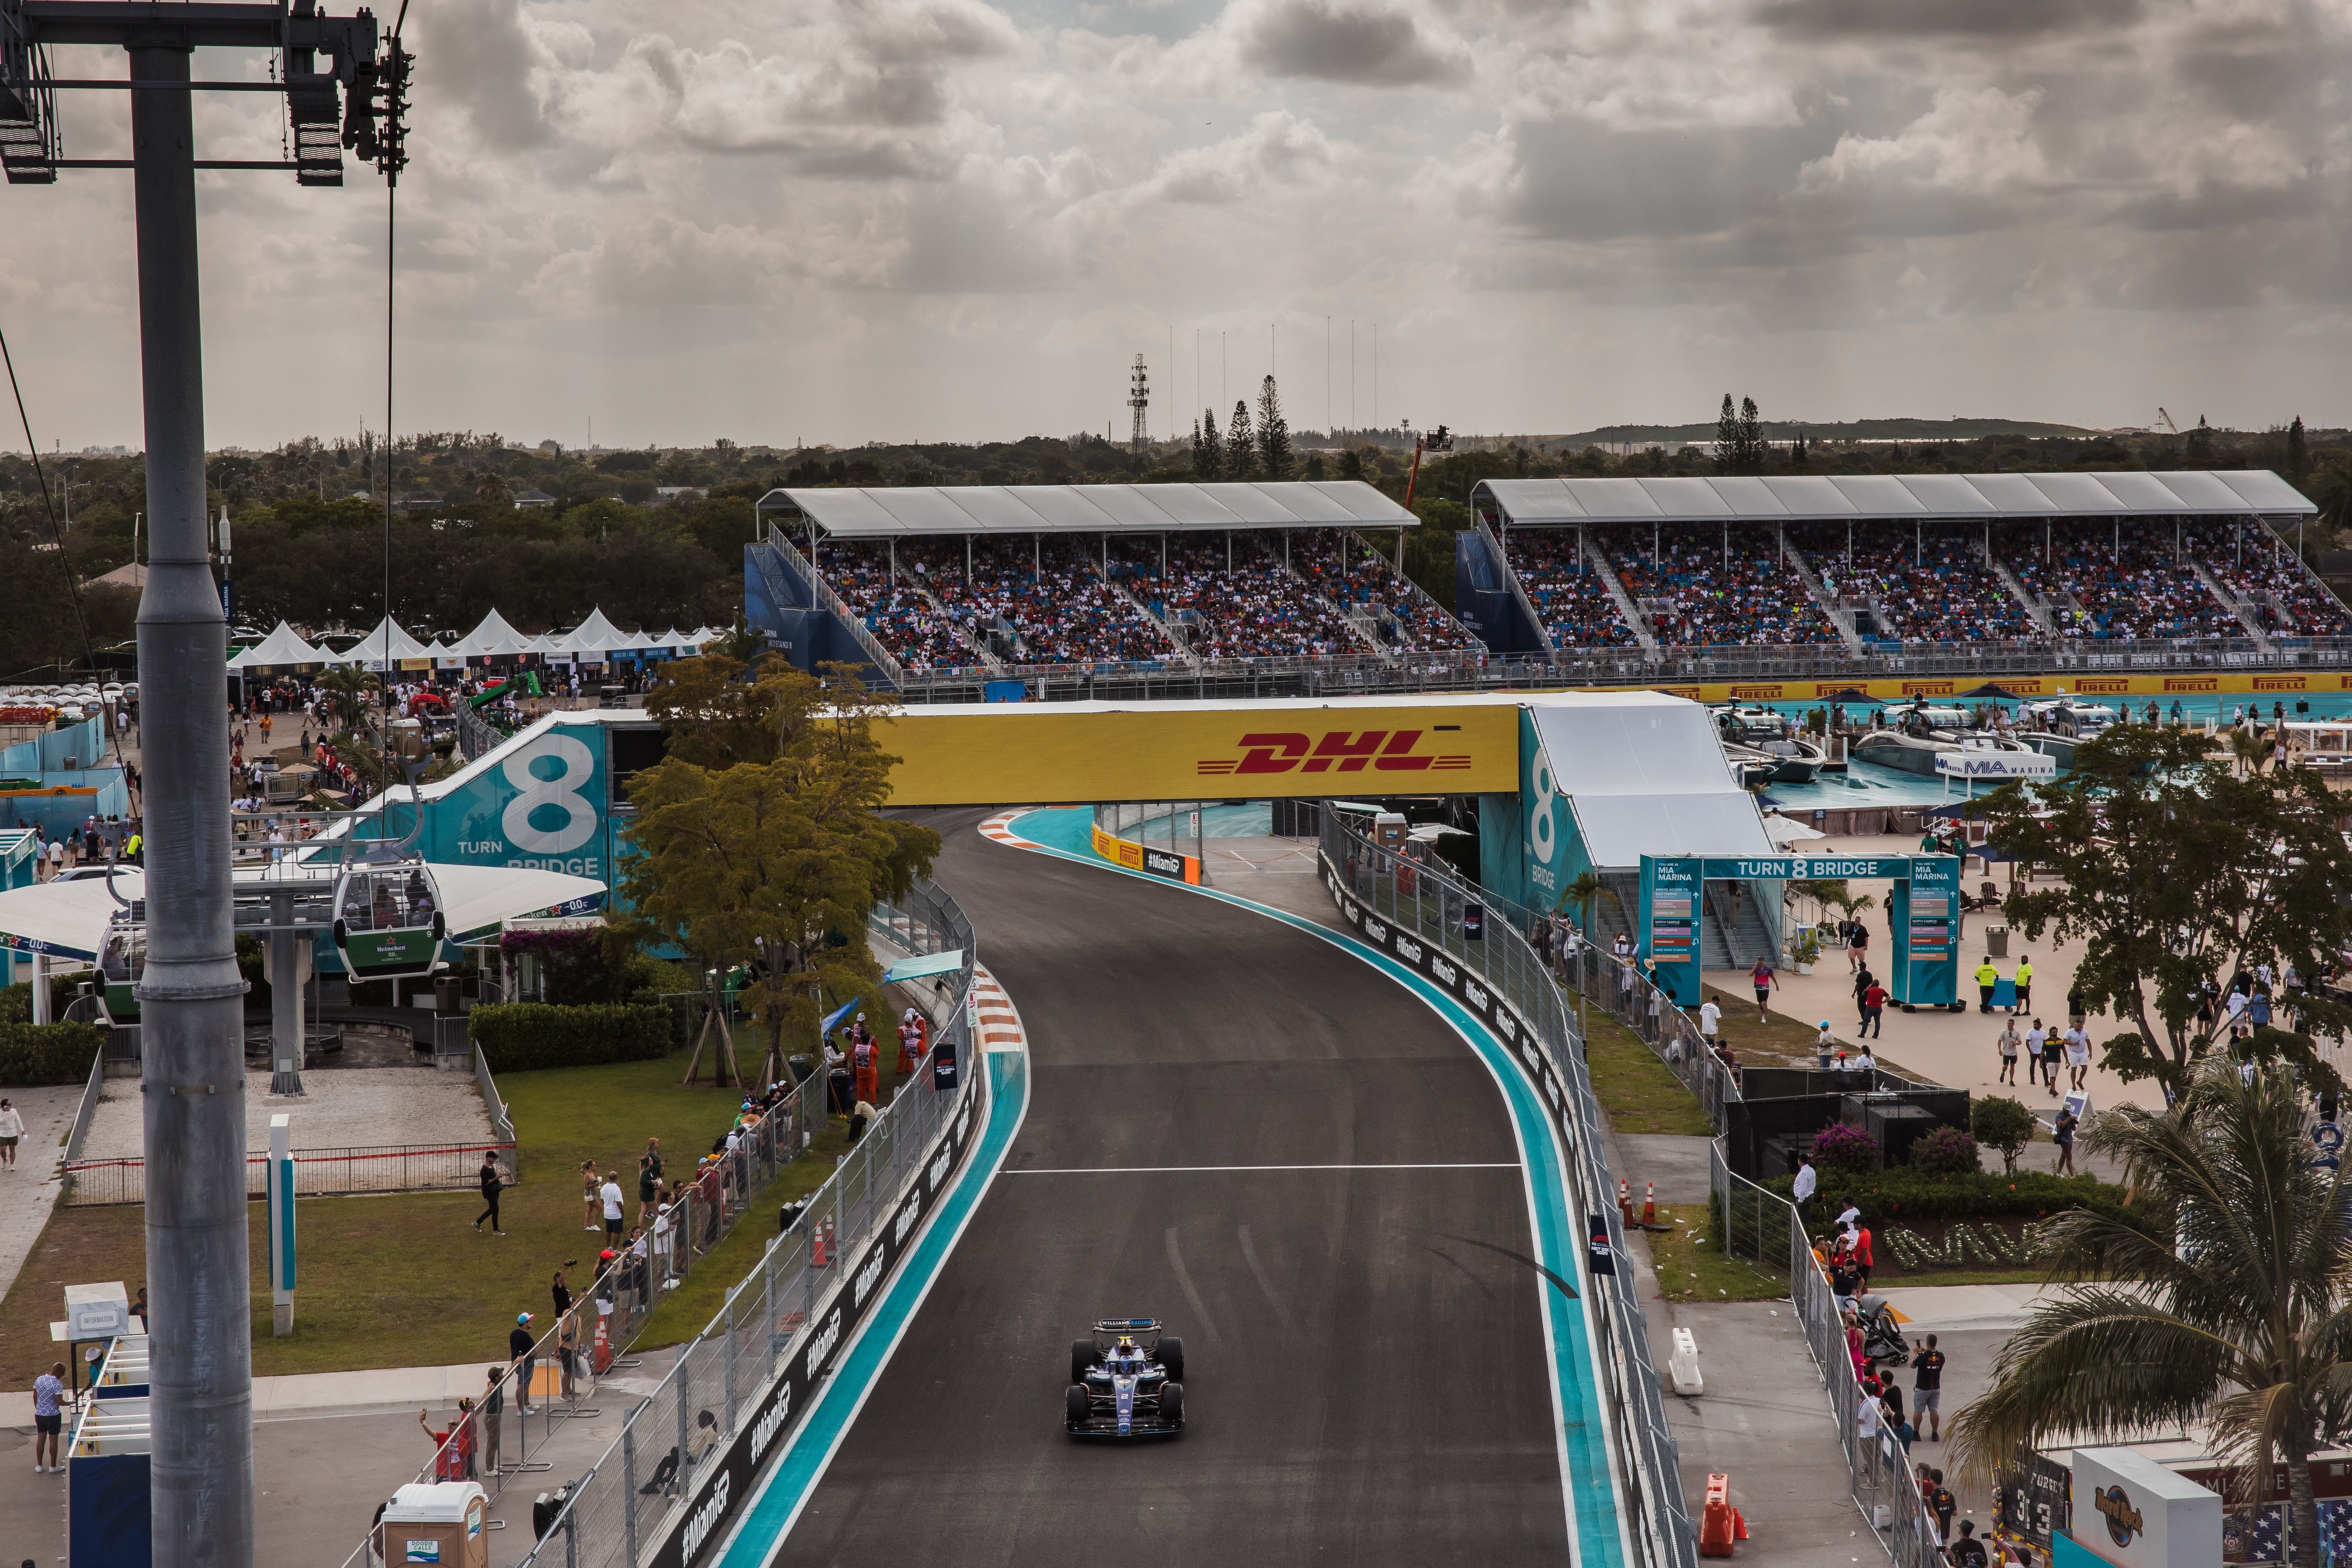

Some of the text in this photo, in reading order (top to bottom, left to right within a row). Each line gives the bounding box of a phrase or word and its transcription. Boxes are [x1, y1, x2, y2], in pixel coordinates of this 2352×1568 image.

[764, 629, 777, 637] ARINA
[768, 640, 789, 648] NDSTAND
[1731, 685, 1783, 699] PIRELLI
[1902, 681, 1954, 695] PIRELLI
[2076, 679, 2129, 691] PIRELLI
[2164, 678, 2218, 690] PIRELLI
[2253, 677, 2306, 690] PIRELLI
[1234, 730, 1435, 774] DHL
[1936, 758, 1949, 769] MIA
[1965, 761, 2008, 774] MIA
[502, 733, 597, 854] 8
[1531, 747, 1554, 863] 8
[458, 842, 502, 854] TURN
[1099, 835, 1109, 855] PIRELLI
[1119, 844, 1139, 866] PIRELLI
[1148, 853, 1179, 873] #MiamiGP
[1738, 859, 1877, 879] TURN 8 BRIDGE
[1533, 864, 1554, 890] BRIDGE
[1366, 916, 1386, 943] #MiamiGP
[1397, 935, 1421, 964] #MiamiGP
[1433, 955, 1455, 986] #MiamiGP
[1466, 979, 1487, 1012] #MiamiGP
[1496, 1005, 1515, 1041] #MiamiGP
[896, 1188, 920, 1247] #MiamiGP
[855, 1243, 884, 1308] #MiamiGP
[84, 1315, 113, 1324] INFORMATION
[808, 1307, 841, 1381] #MiamiGP
[751, 1381, 790, 1465] #MiamiGP
[469, 1508, 479, 1521] DOODIE
[470, 1515, 479, 1526] CALLS
[682, 1469, 730, 1568] #MiamiGP
[2096, 1486, 2143, 1538] Hard Rock
